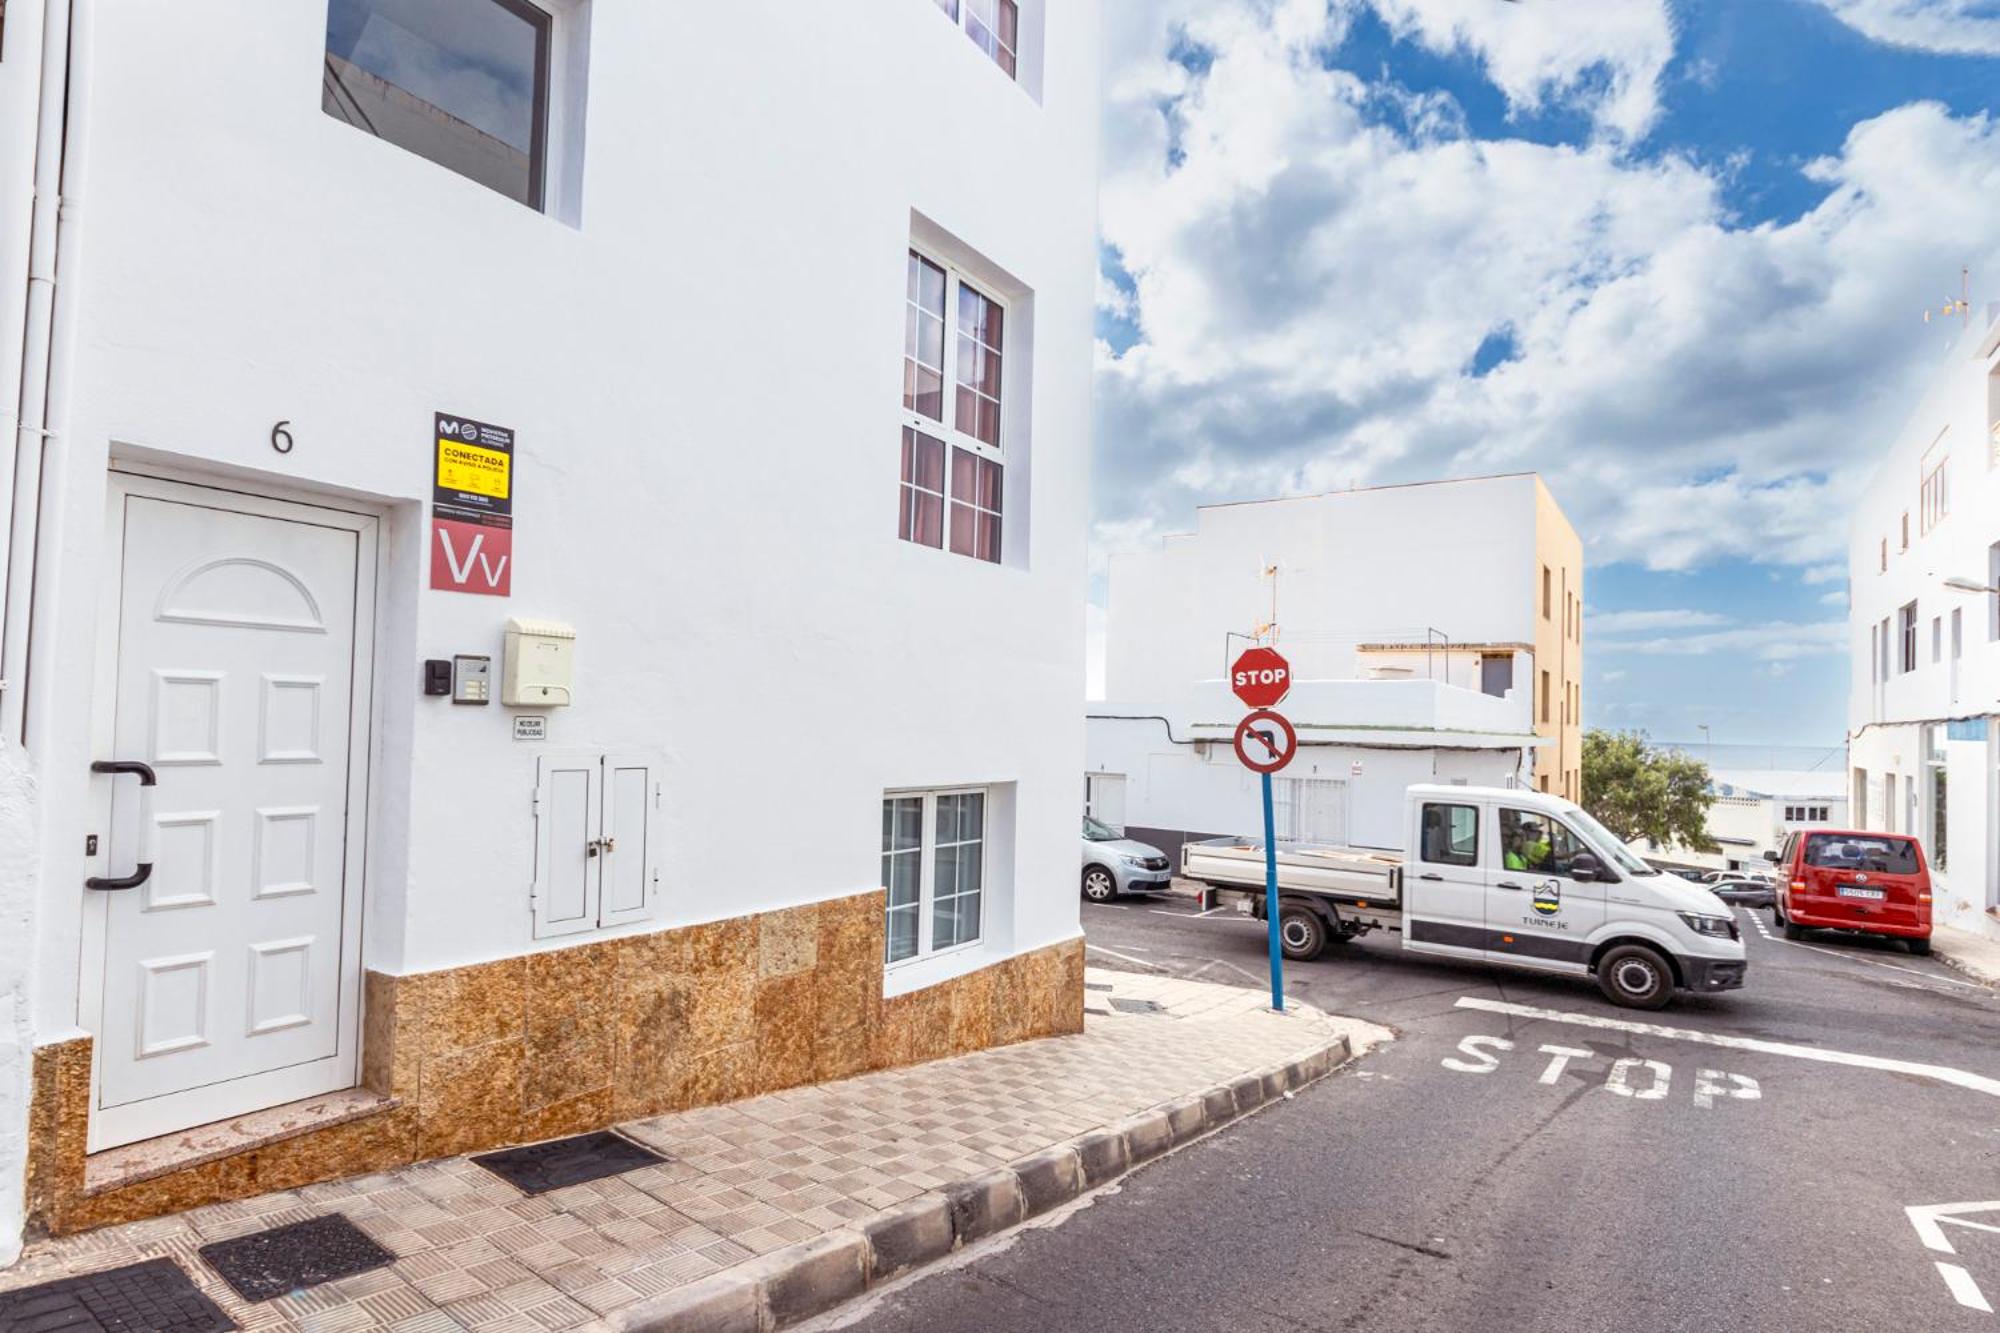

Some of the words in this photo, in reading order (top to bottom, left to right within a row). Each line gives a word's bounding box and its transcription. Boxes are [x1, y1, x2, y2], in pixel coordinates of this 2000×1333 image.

[271, 420, 293, 454] 6
[444, 447, 504, 467] CONECTADA
[1235, 668, 1286, 686] STOP
[1440, 1034, 1763, 1109] STOP
